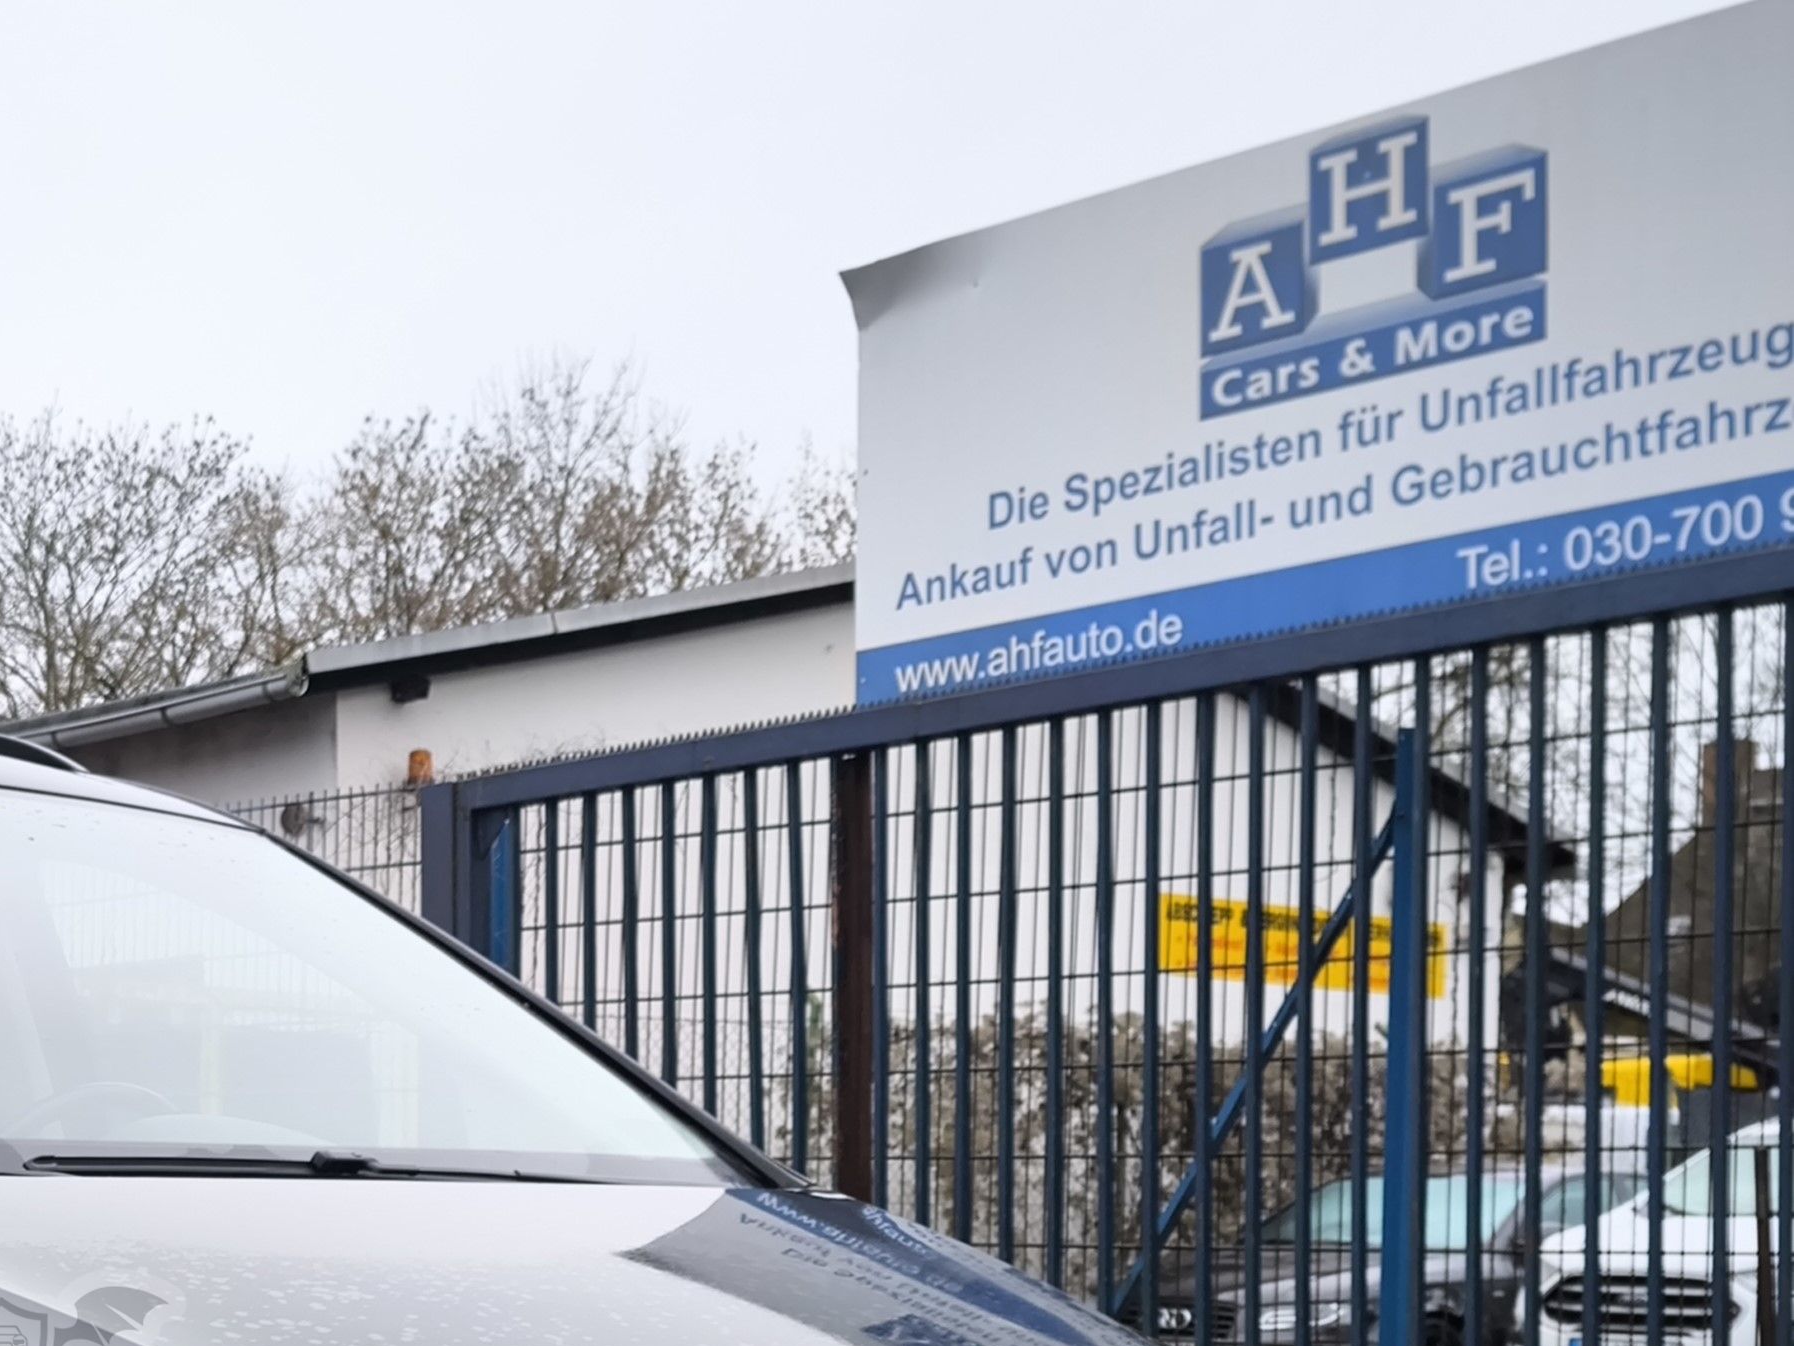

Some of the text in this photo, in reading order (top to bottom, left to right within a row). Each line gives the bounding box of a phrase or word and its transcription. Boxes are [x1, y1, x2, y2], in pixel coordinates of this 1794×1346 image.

[1208, 130, 1536, 343] AHF
[1210, 304, 1534, 407] Cars & More
[988, 320, 1794, 531] Die Spezialisten für Unfallfahrzeug
[895, 546, 1034, 611] Ankauf
[1044, 538, 1118, 579] von
[1133, 499, 1275, 561] Unfall-
[1288, 473, 1374, 529] und
[1455, 538, 1549, 590] Tel.:
[1563, 493, 1764, 572] 030-700
[894, 608, 1184, 693] www.ahfauto.de
